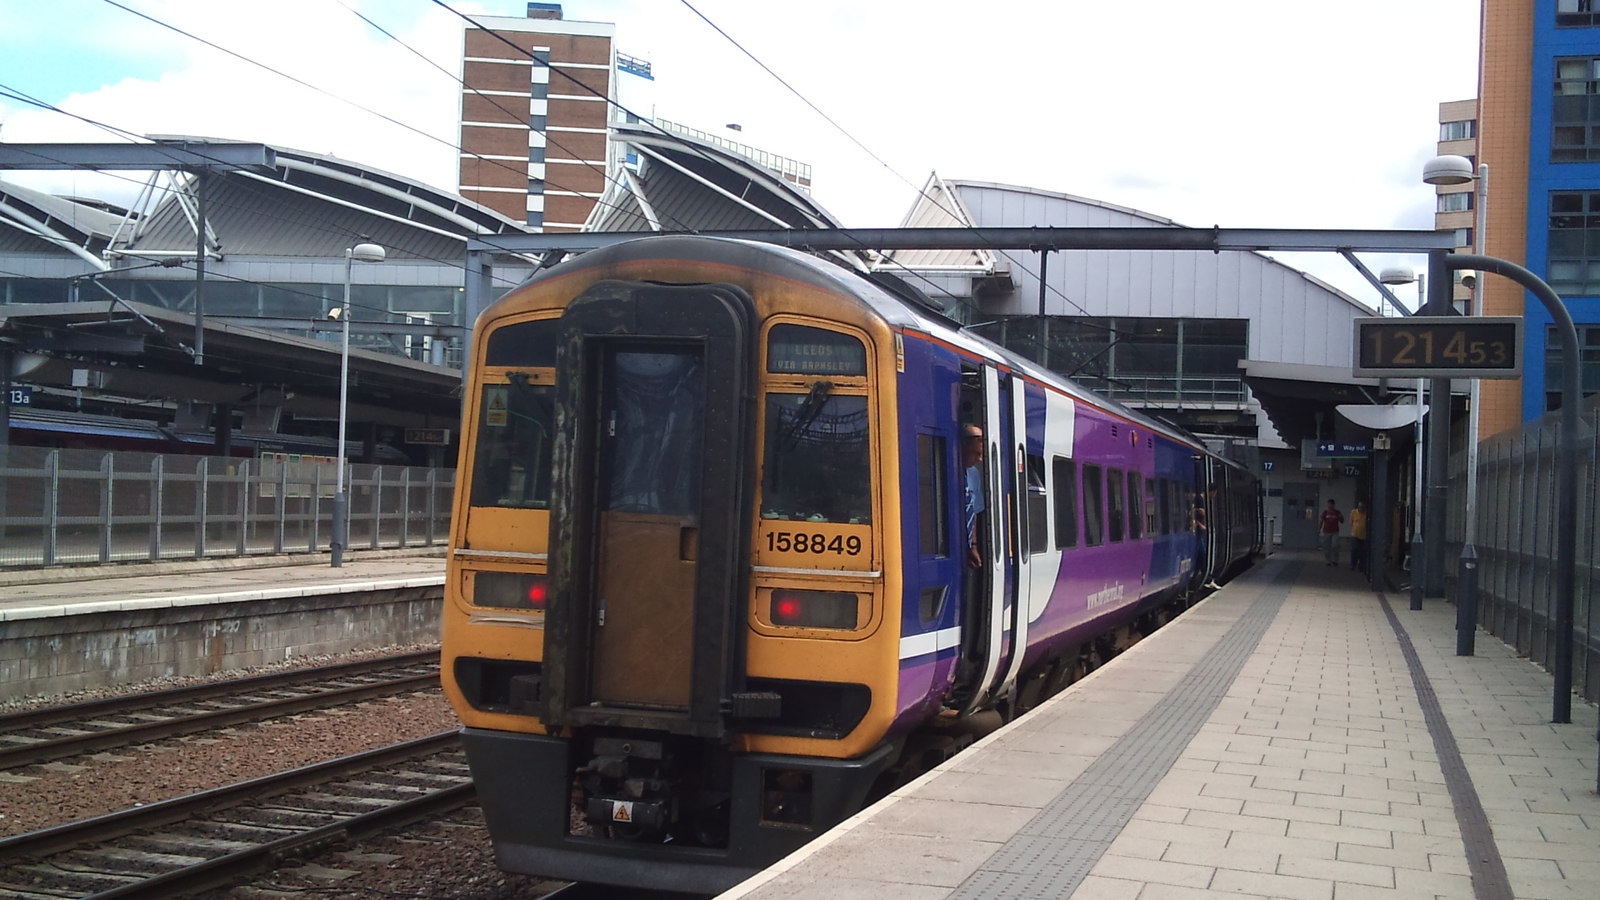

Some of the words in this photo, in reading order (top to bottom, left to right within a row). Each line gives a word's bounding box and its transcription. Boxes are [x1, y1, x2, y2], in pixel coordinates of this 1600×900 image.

[795, 344, 833, 356] LEEDS
[777, 360, 796, 370] VIA
[10, 390, 30, 404] 13a
[1264, 462, 1273, 470] 17
[766, 531, 862, 556] 158849
